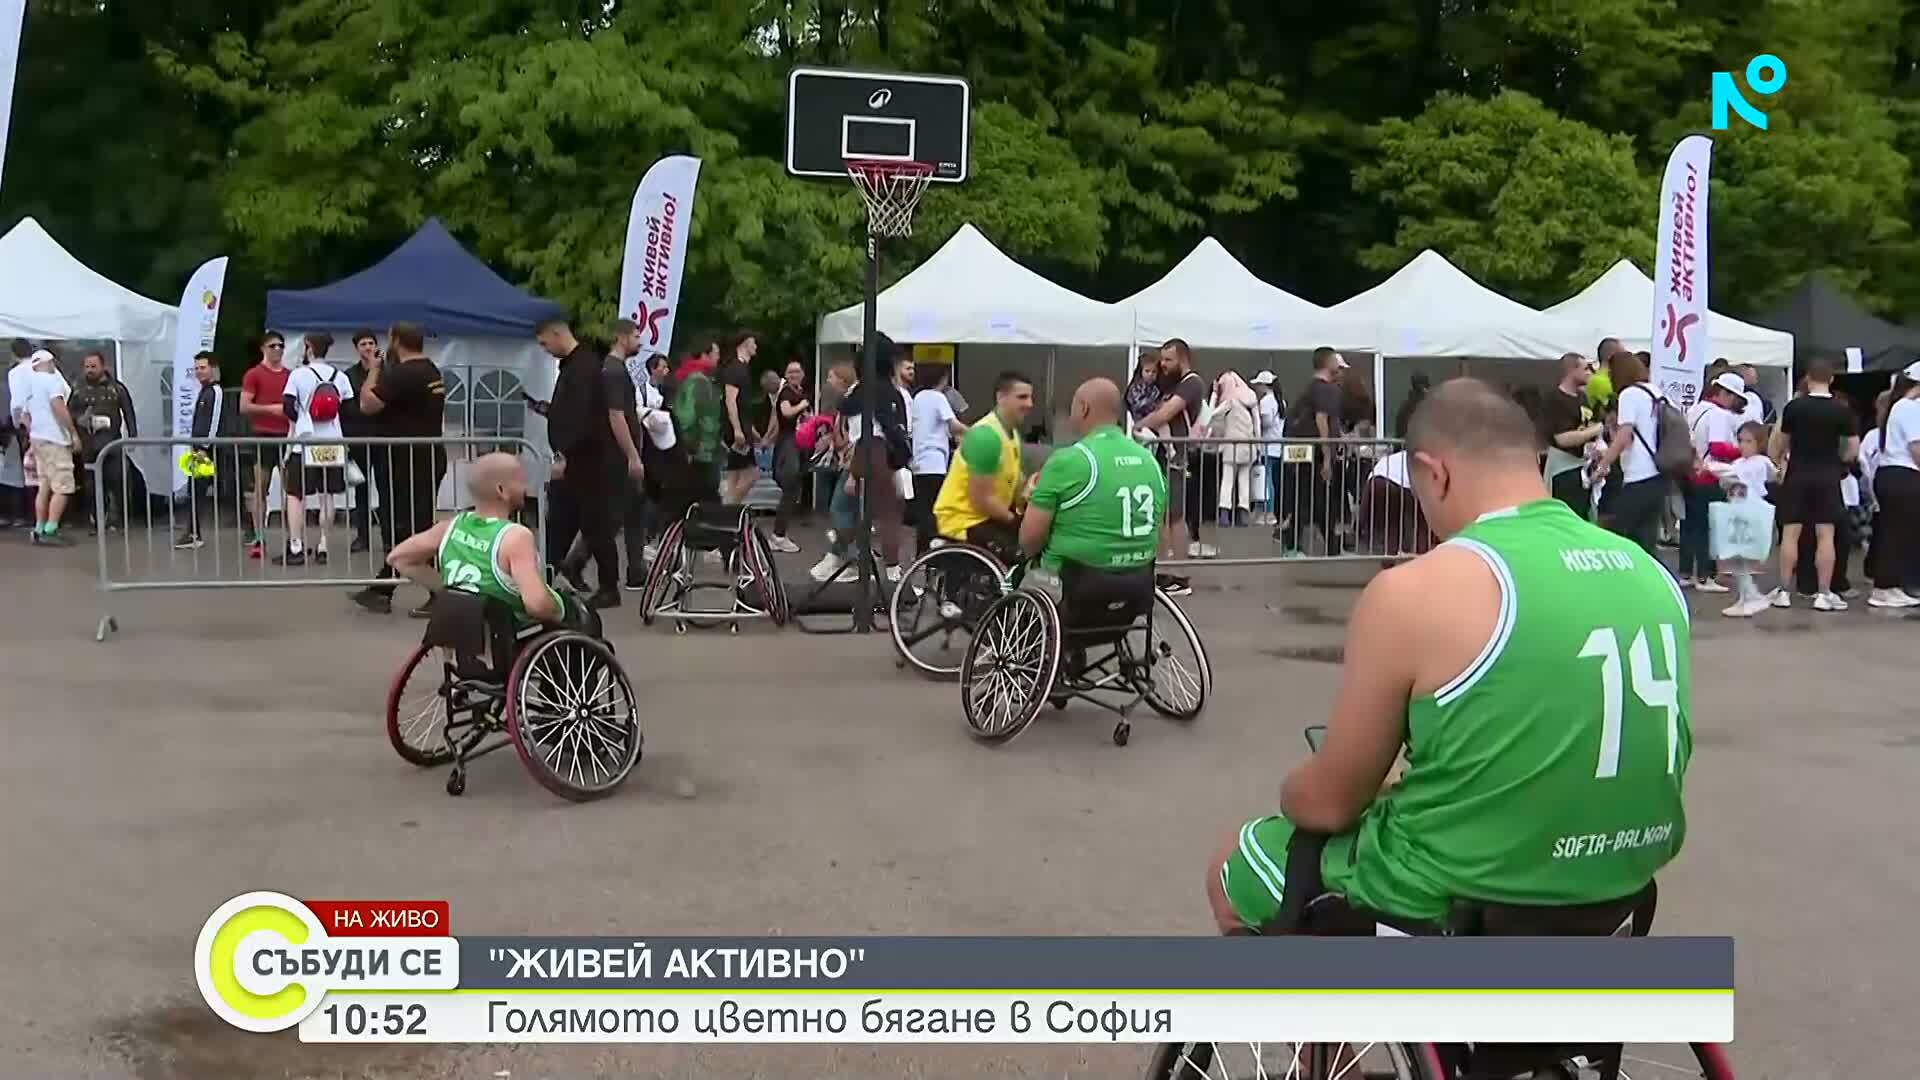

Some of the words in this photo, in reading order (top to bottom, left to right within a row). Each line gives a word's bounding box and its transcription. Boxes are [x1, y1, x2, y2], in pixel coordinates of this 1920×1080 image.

[642, 216, 662, 296] живей
[655, 192, 677, 300] активно!
[1115, 484, 1154, 537] 13
[1577, 623, 1679, 780] 14
